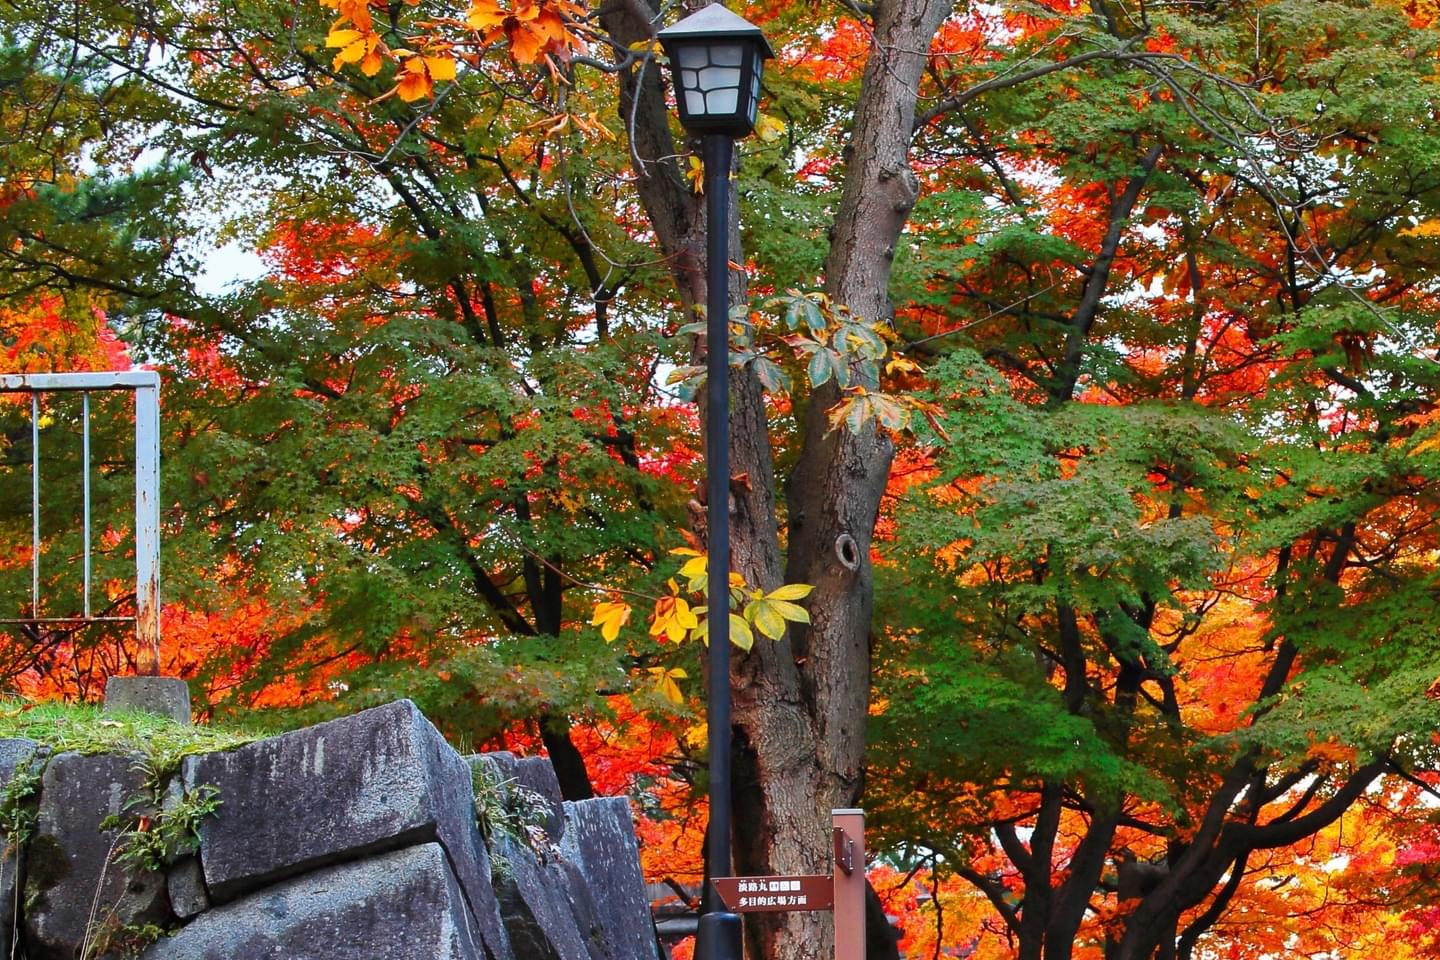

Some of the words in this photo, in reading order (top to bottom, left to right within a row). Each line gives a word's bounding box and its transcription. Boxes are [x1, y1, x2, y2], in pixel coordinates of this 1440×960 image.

[739, 895, 807, 907] 多目的広場方面
